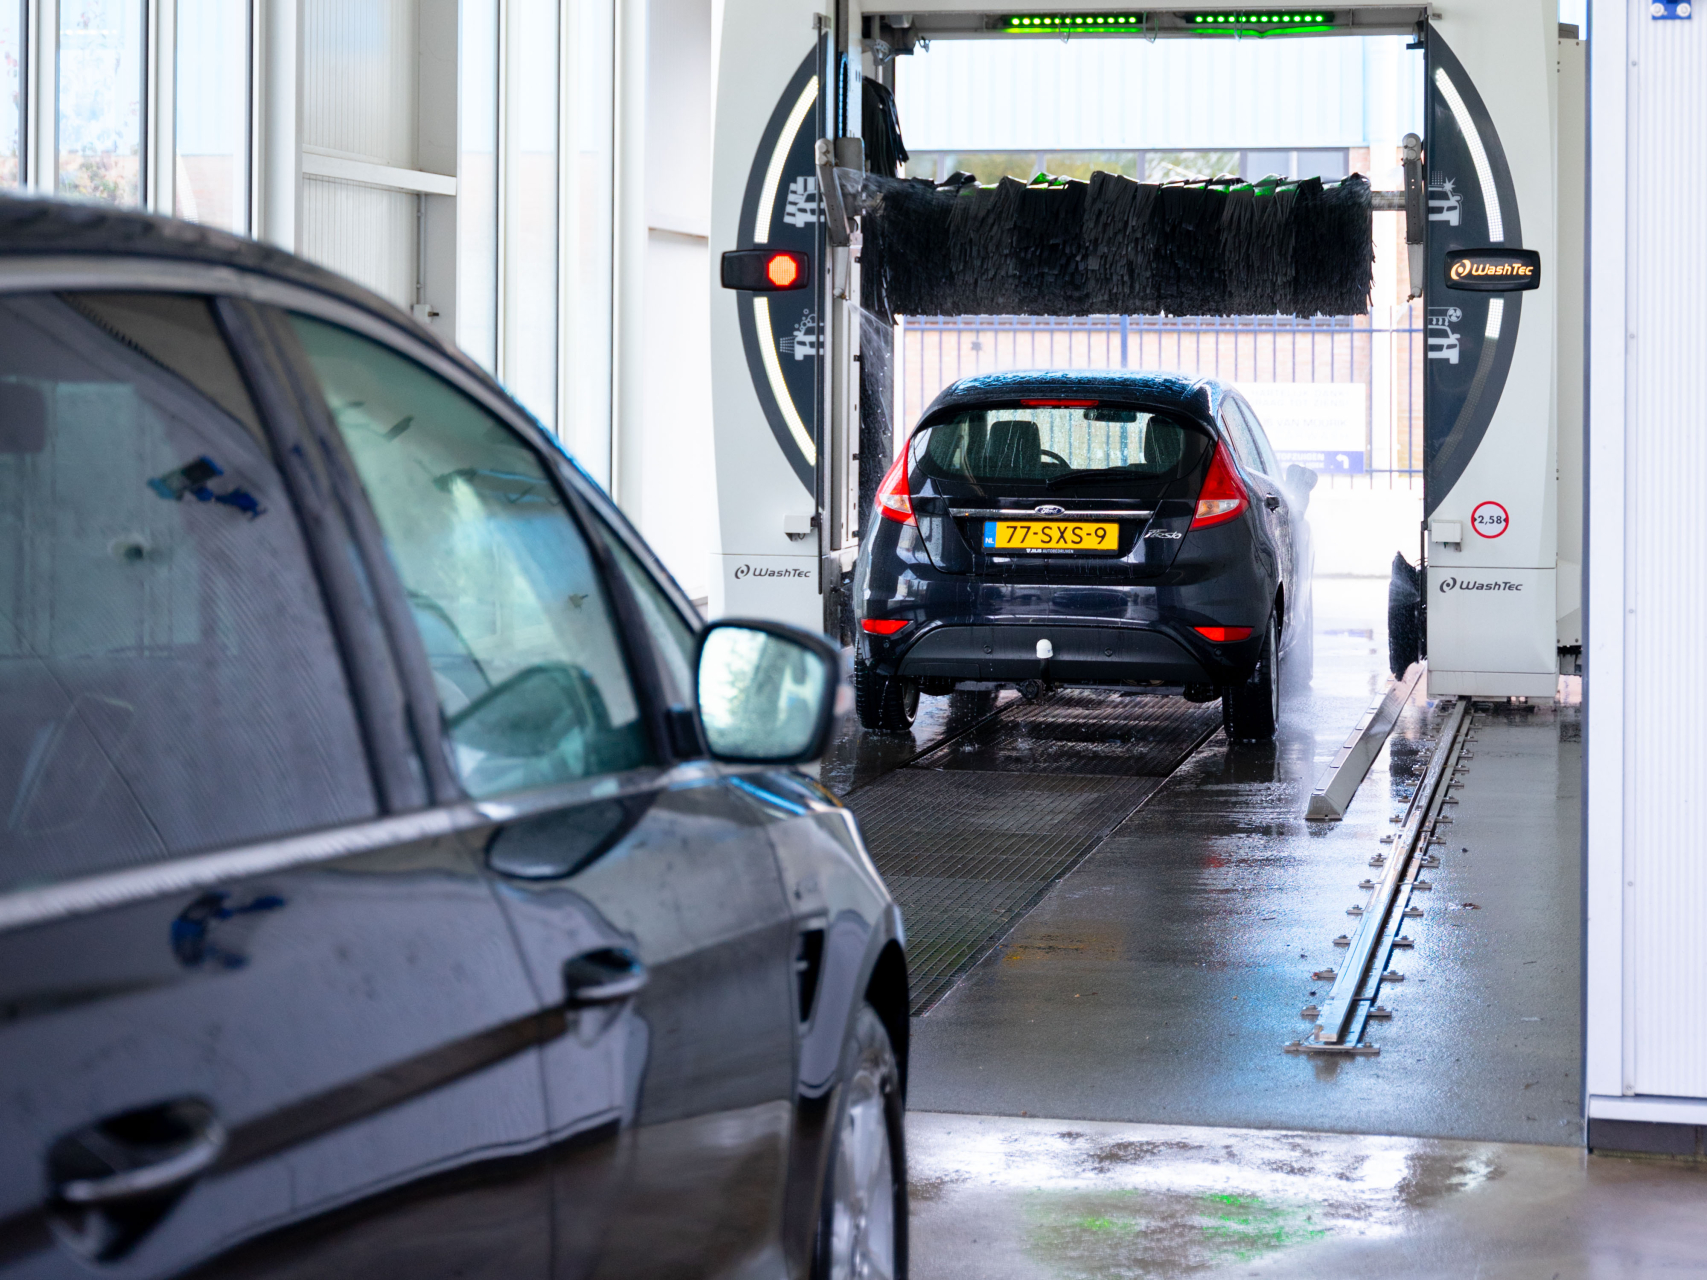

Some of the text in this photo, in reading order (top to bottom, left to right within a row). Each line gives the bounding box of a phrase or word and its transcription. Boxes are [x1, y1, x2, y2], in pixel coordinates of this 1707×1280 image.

[1471, 263, 1534, 276] WashTec
[1275, 452, 1325, 461] TOFZUIGEN
[1477, 515, 1503, 526] 2,58
[1006, 526, 1107, 545] 77-SXS-9
[752, 567, 811, 578] WashTec
[1459, 580, 1523, 592] WashTec
